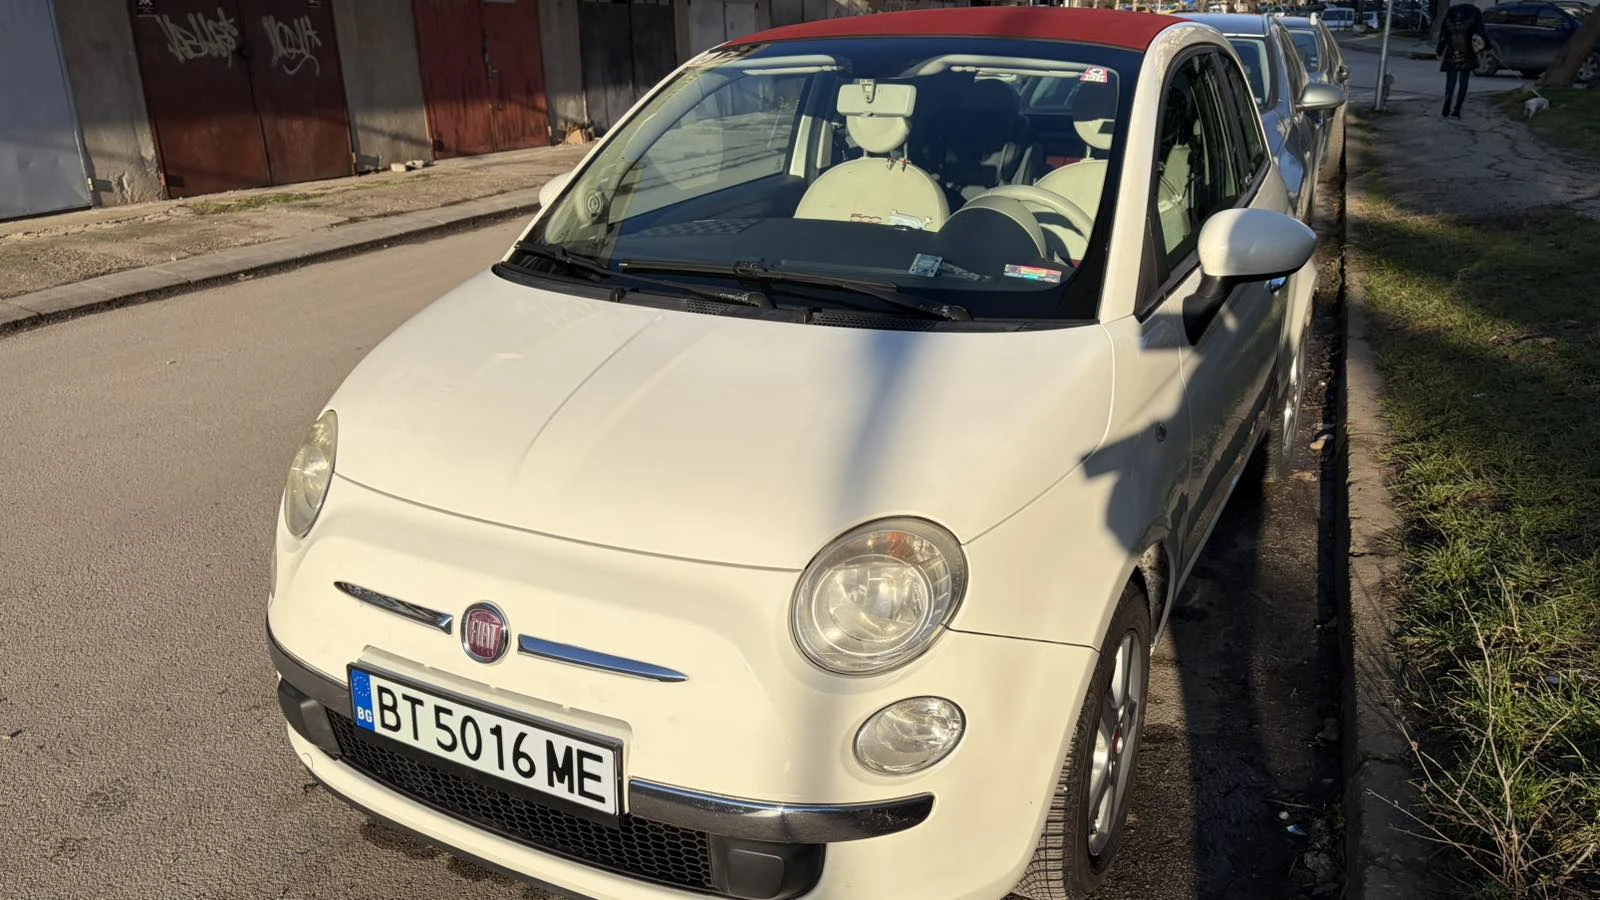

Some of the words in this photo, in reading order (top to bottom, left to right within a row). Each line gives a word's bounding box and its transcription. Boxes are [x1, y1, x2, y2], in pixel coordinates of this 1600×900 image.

[470, 619, 500, 650] FIAT
[357, 706, 373, 723] BG
[377, 685, 424, 741] BT
[434, 704, 536, 779] 5016
[546, 739, 606, 804] ME
